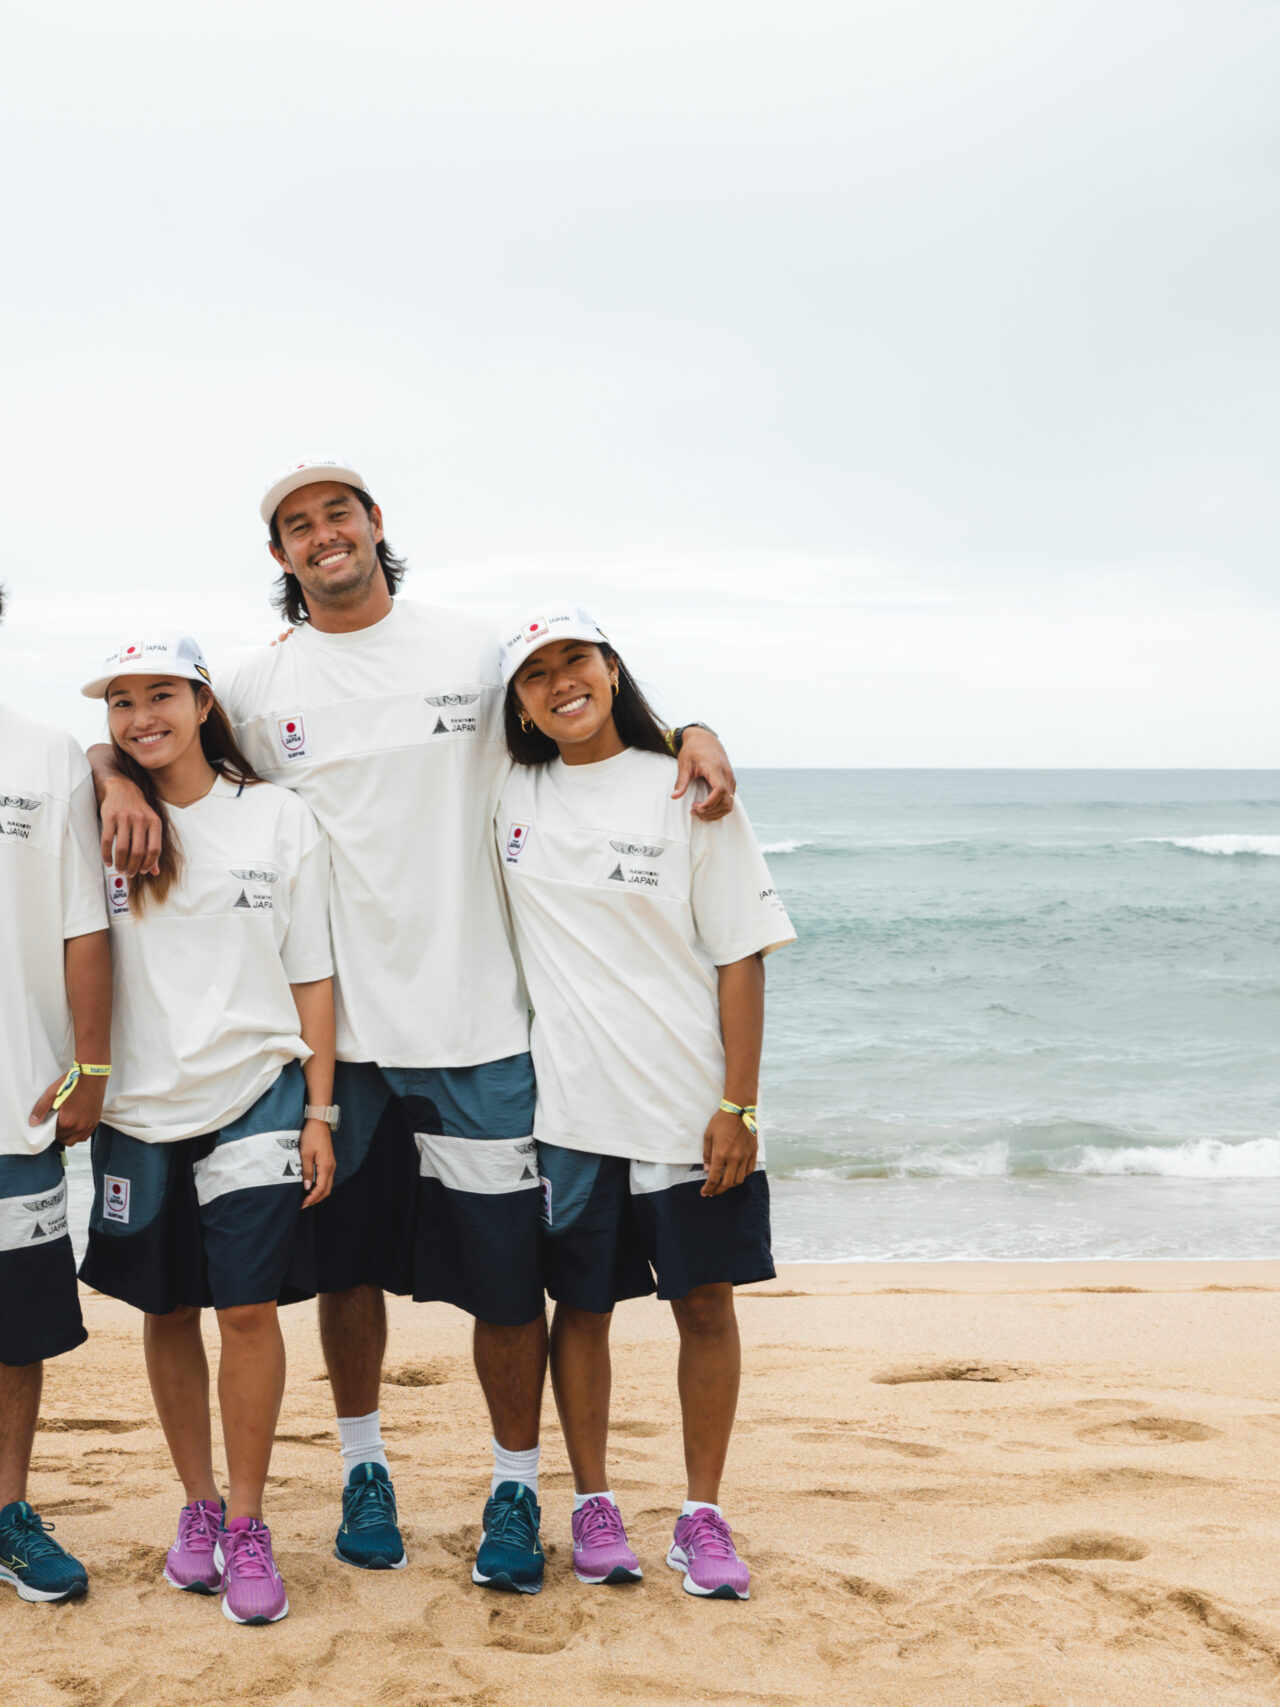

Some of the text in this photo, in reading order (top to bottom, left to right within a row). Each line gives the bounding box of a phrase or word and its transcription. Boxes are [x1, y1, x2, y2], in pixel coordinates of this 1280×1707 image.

[549, 615, 570, 624] JAPAN
[507, 634, 522, 648] TEAM
[451, 724, 477, 732] JAPAN
[7, 828, 30, 838] JAPAN
[628, 876, 658, 887] JAPAN
